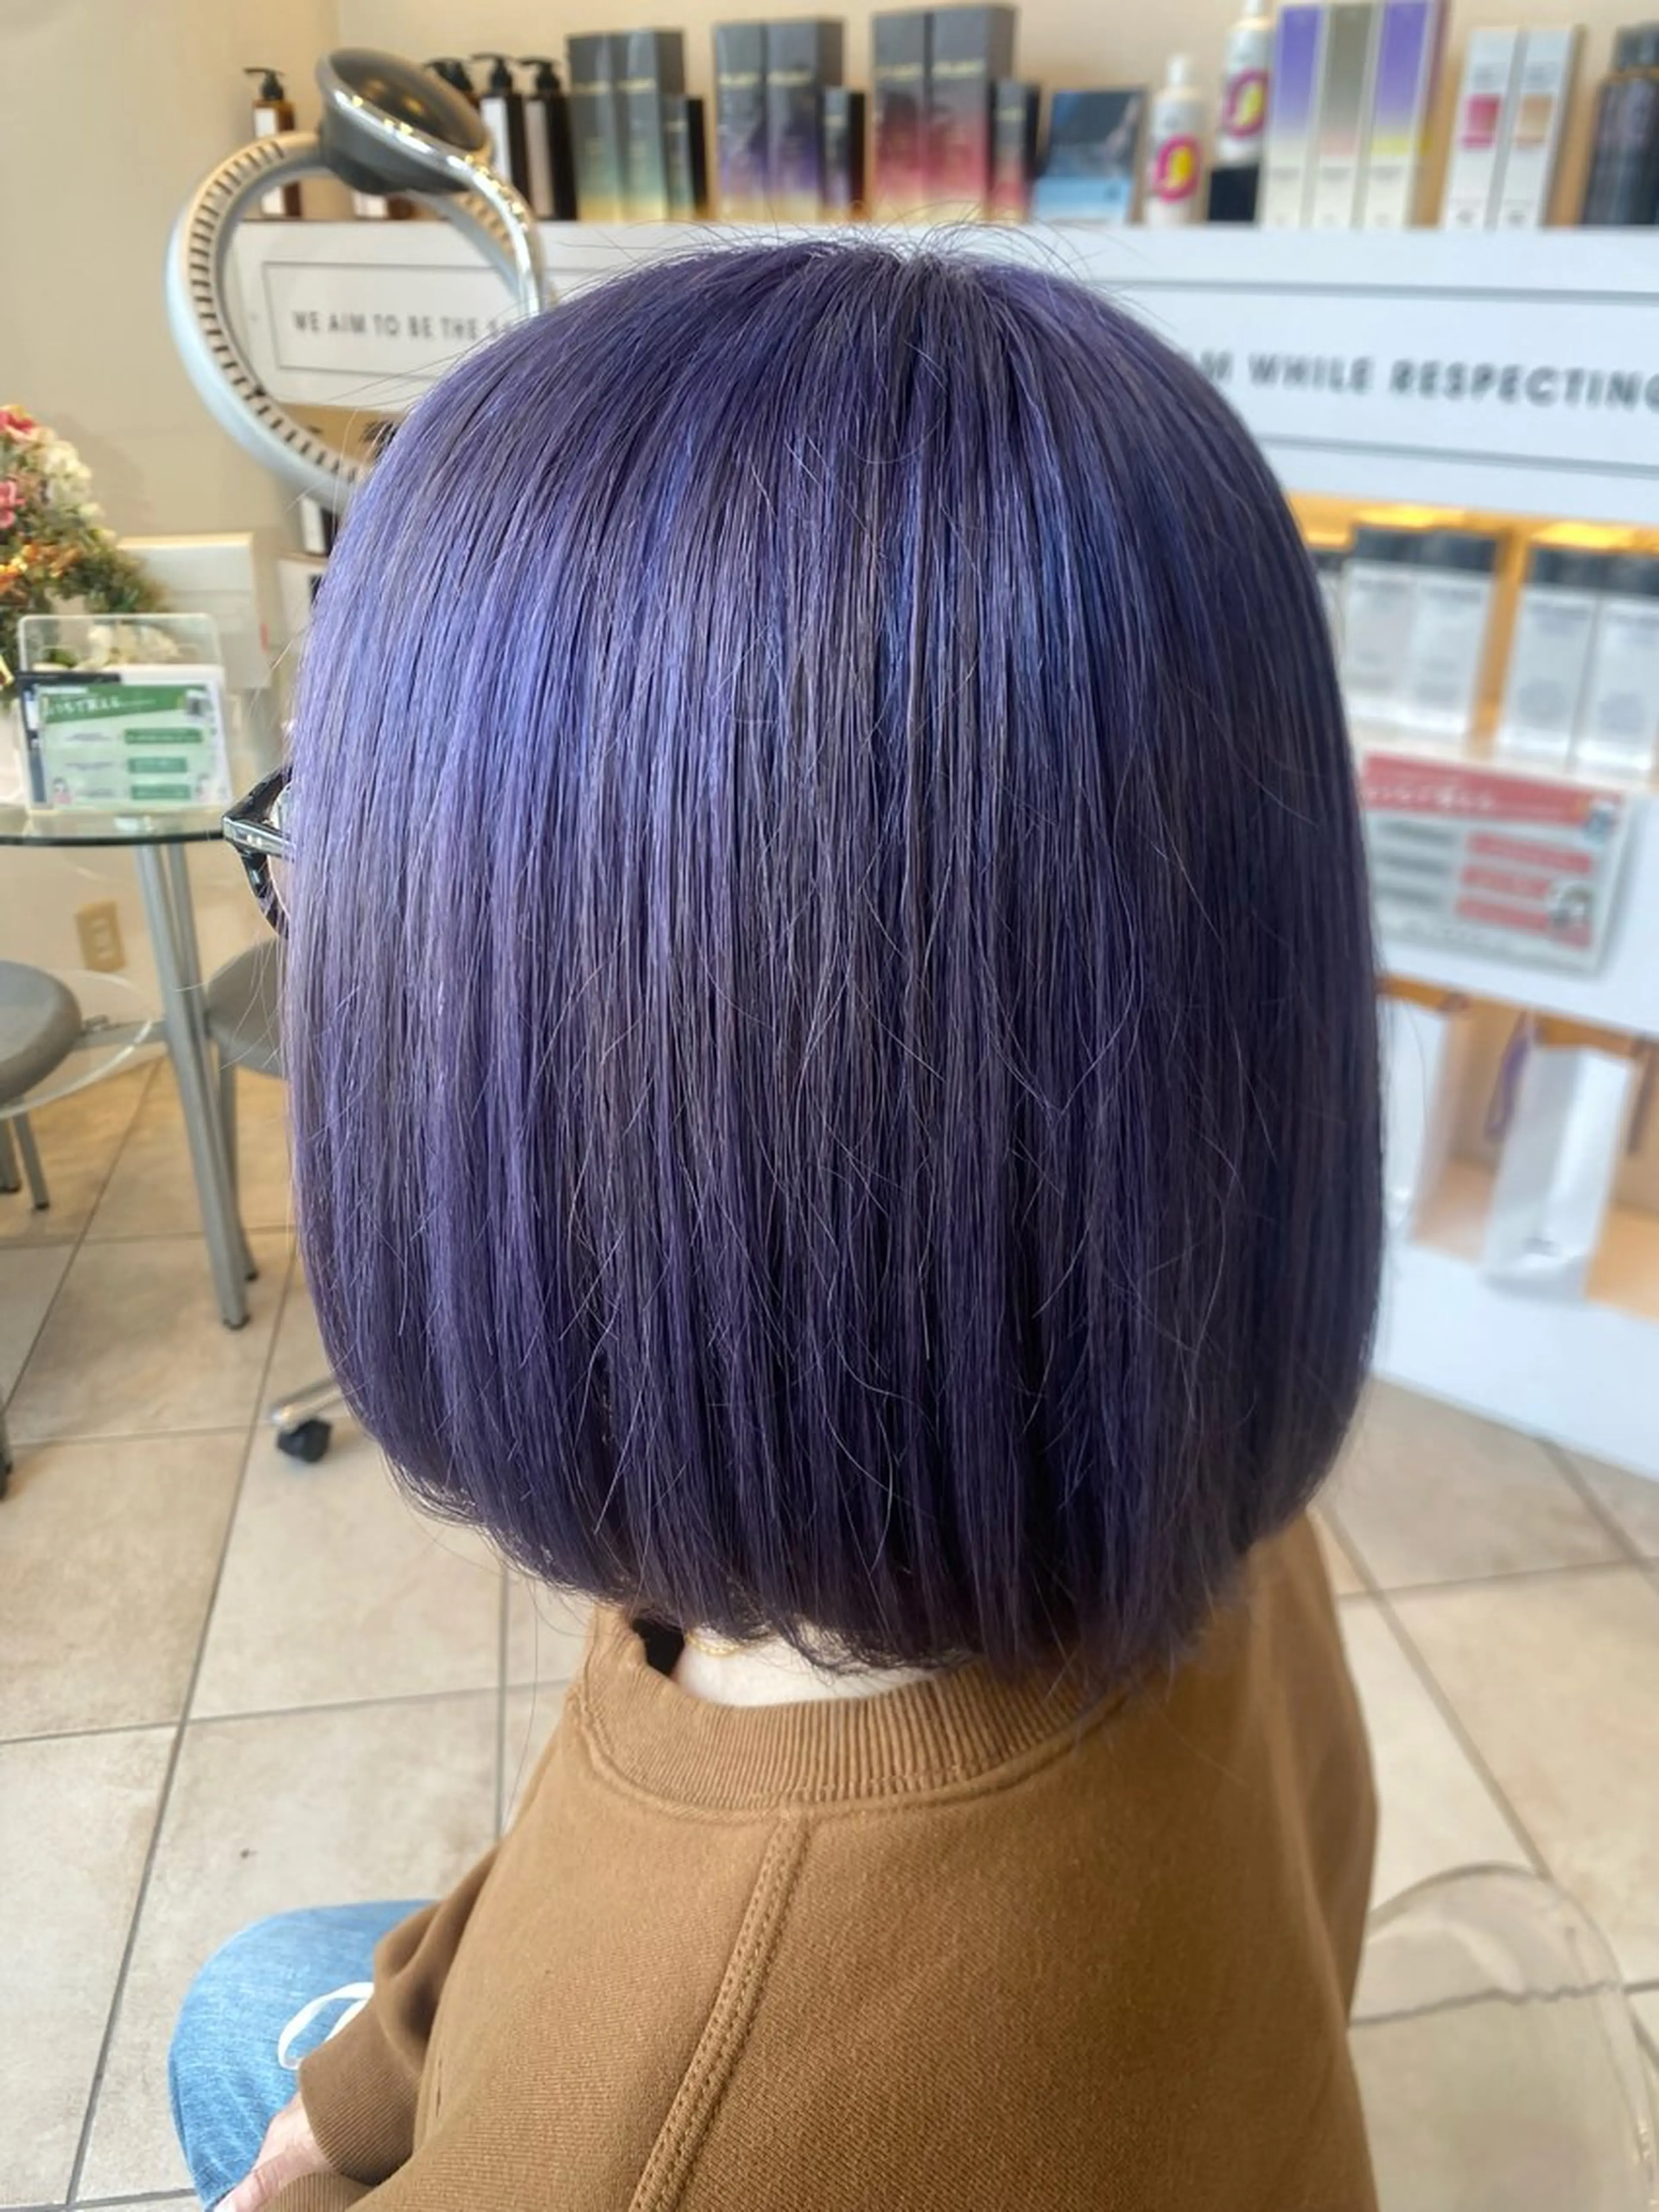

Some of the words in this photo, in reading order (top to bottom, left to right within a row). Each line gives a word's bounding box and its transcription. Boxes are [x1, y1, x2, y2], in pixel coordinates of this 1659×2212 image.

[293, 309, 320, 333] WE
[327, 311, 367, 335] AIM
[373, 313, 401, 339] TO
[407, 315, 433, 340] BE
[439, 316, 477, 342] THE
[1248, 350, 1375, 395] WHILE
